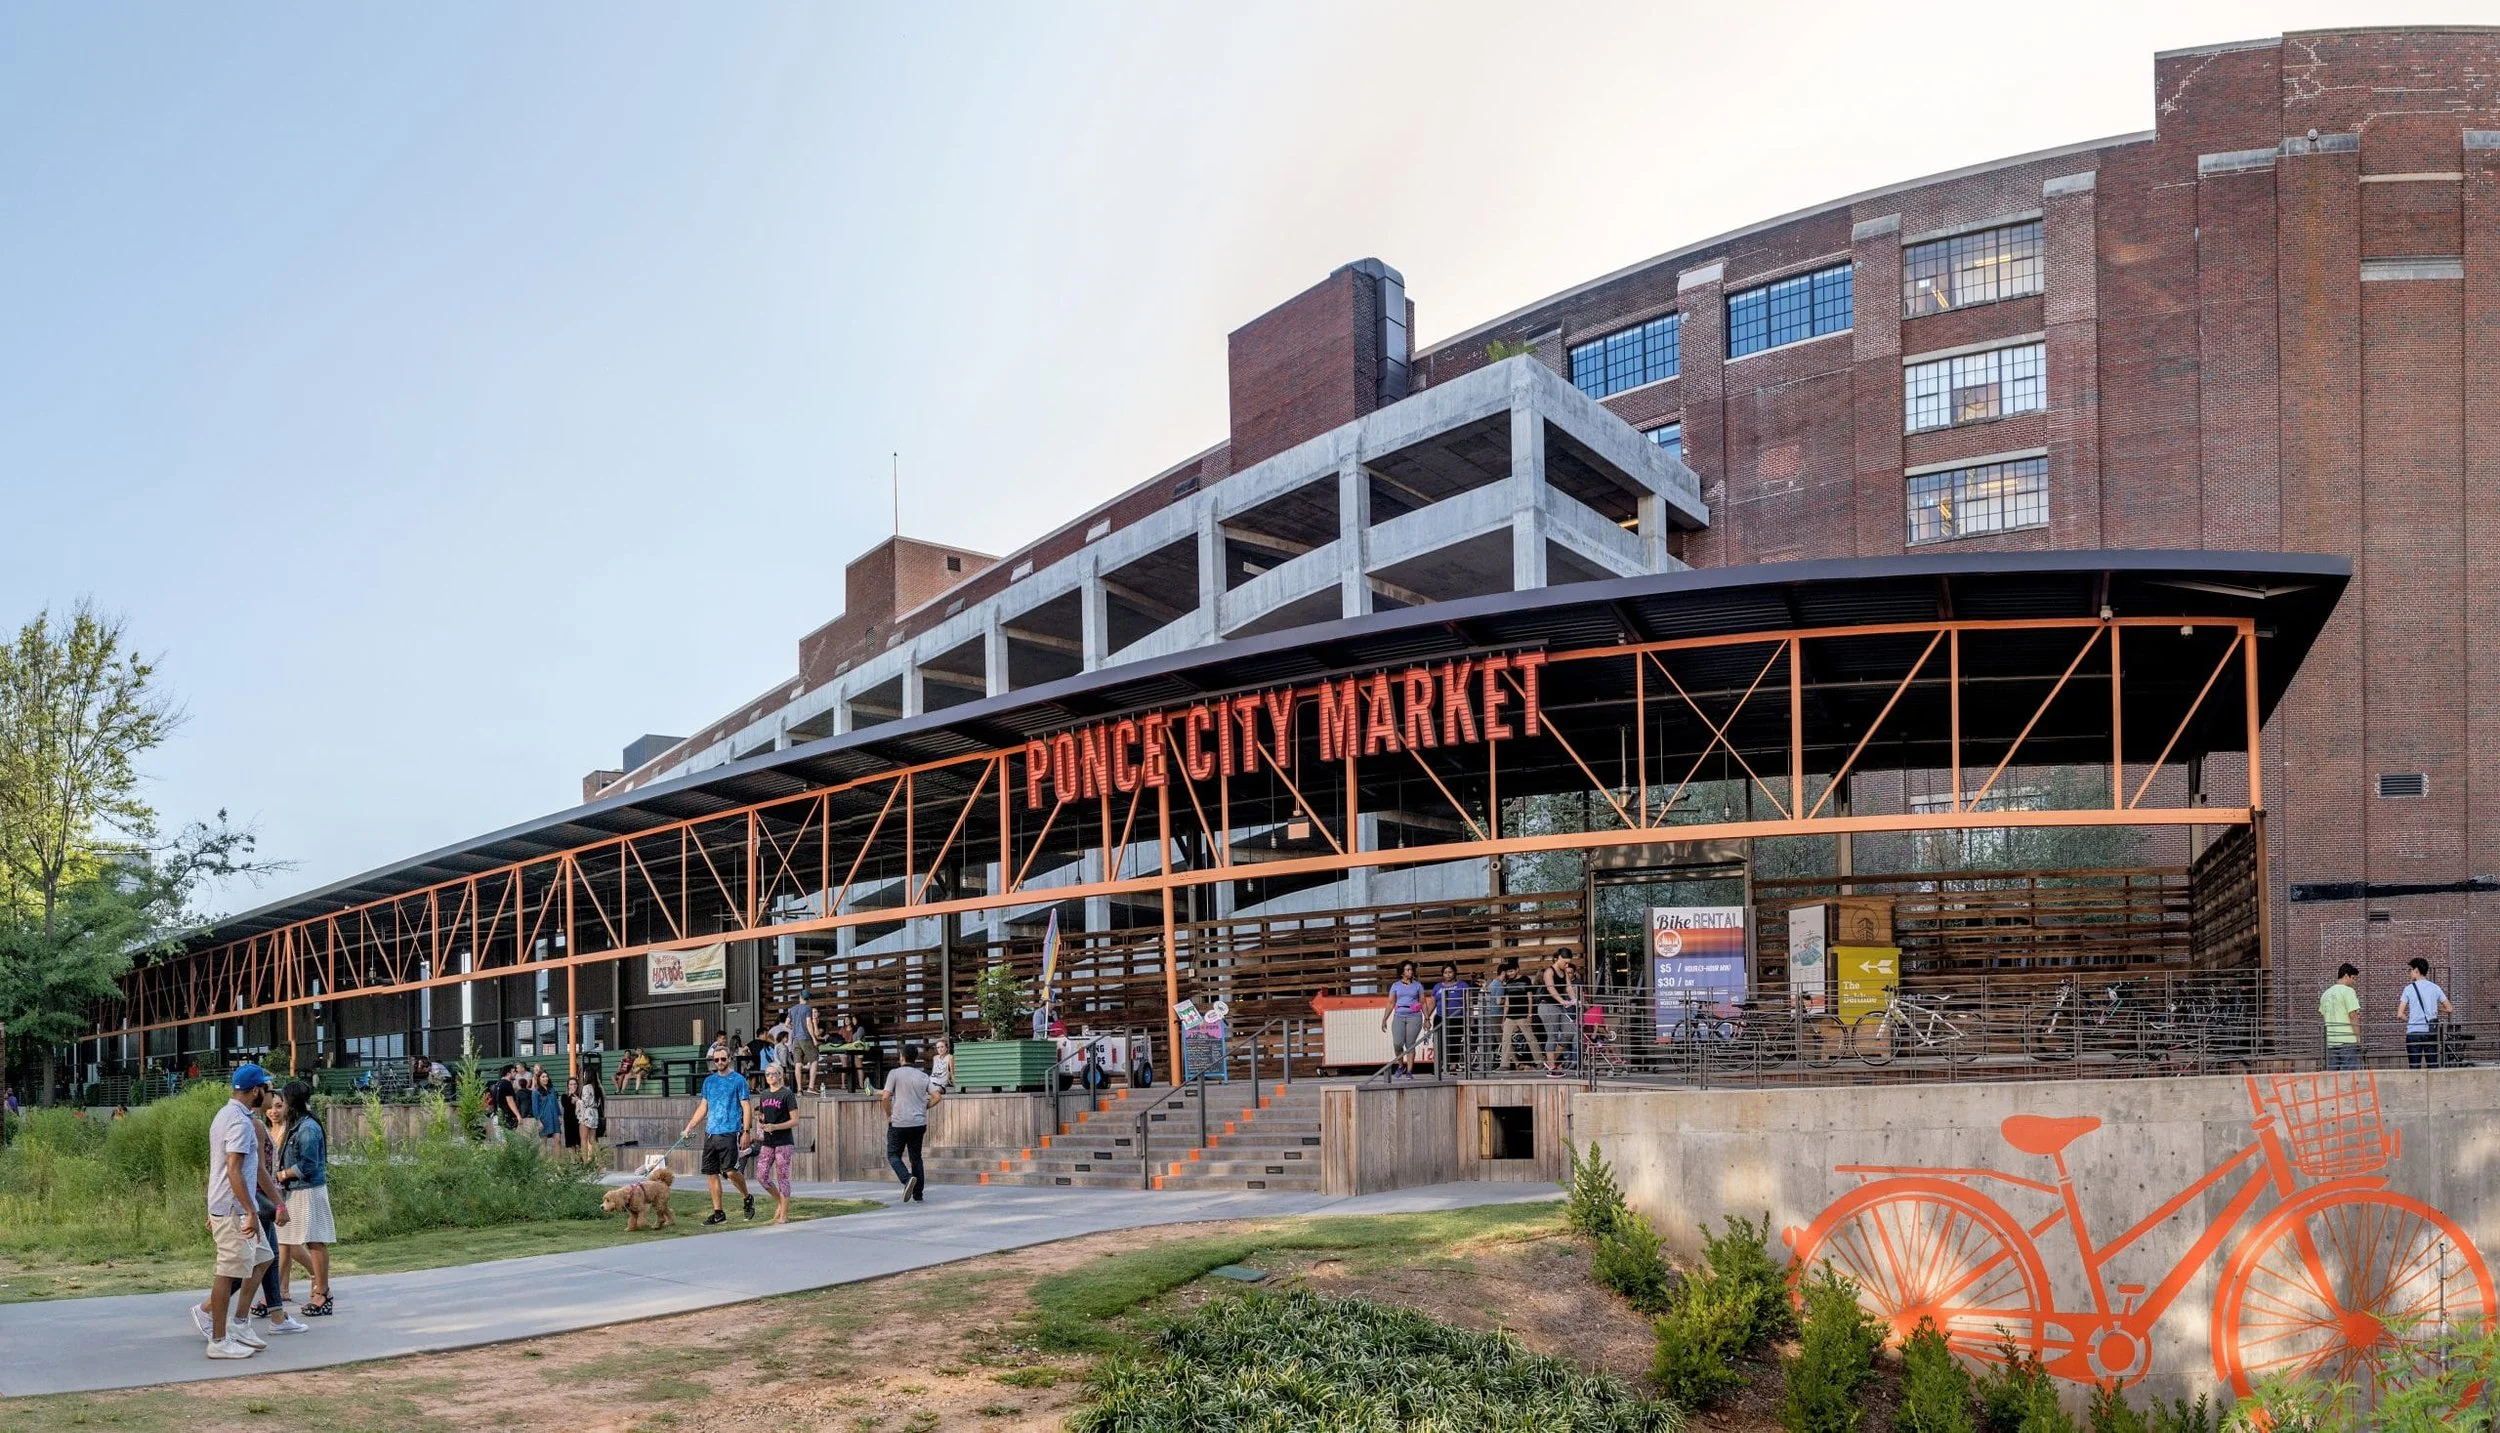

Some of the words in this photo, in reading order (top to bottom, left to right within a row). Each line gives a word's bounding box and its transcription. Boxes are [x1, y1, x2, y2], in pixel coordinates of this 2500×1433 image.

[1026, 713, 1170, 809] PONCE
[1186, 688, 1297, 781] CITY
[1319, 651, 1549, 762] MARKET
[1656, 914, 1691, 930] Bike
[1693, 912, 1740, 929] RENTAL
[1660, 963, 1672, 974] $5
[1657, 977, 1675, 988] $30
[1684, 979, 1695, 987] DAY
[1843, 979, 1860, 990] The
[1086, 1044, 1105, 1053] KNG
[1086, 1056, 1106, 1065] PPS
